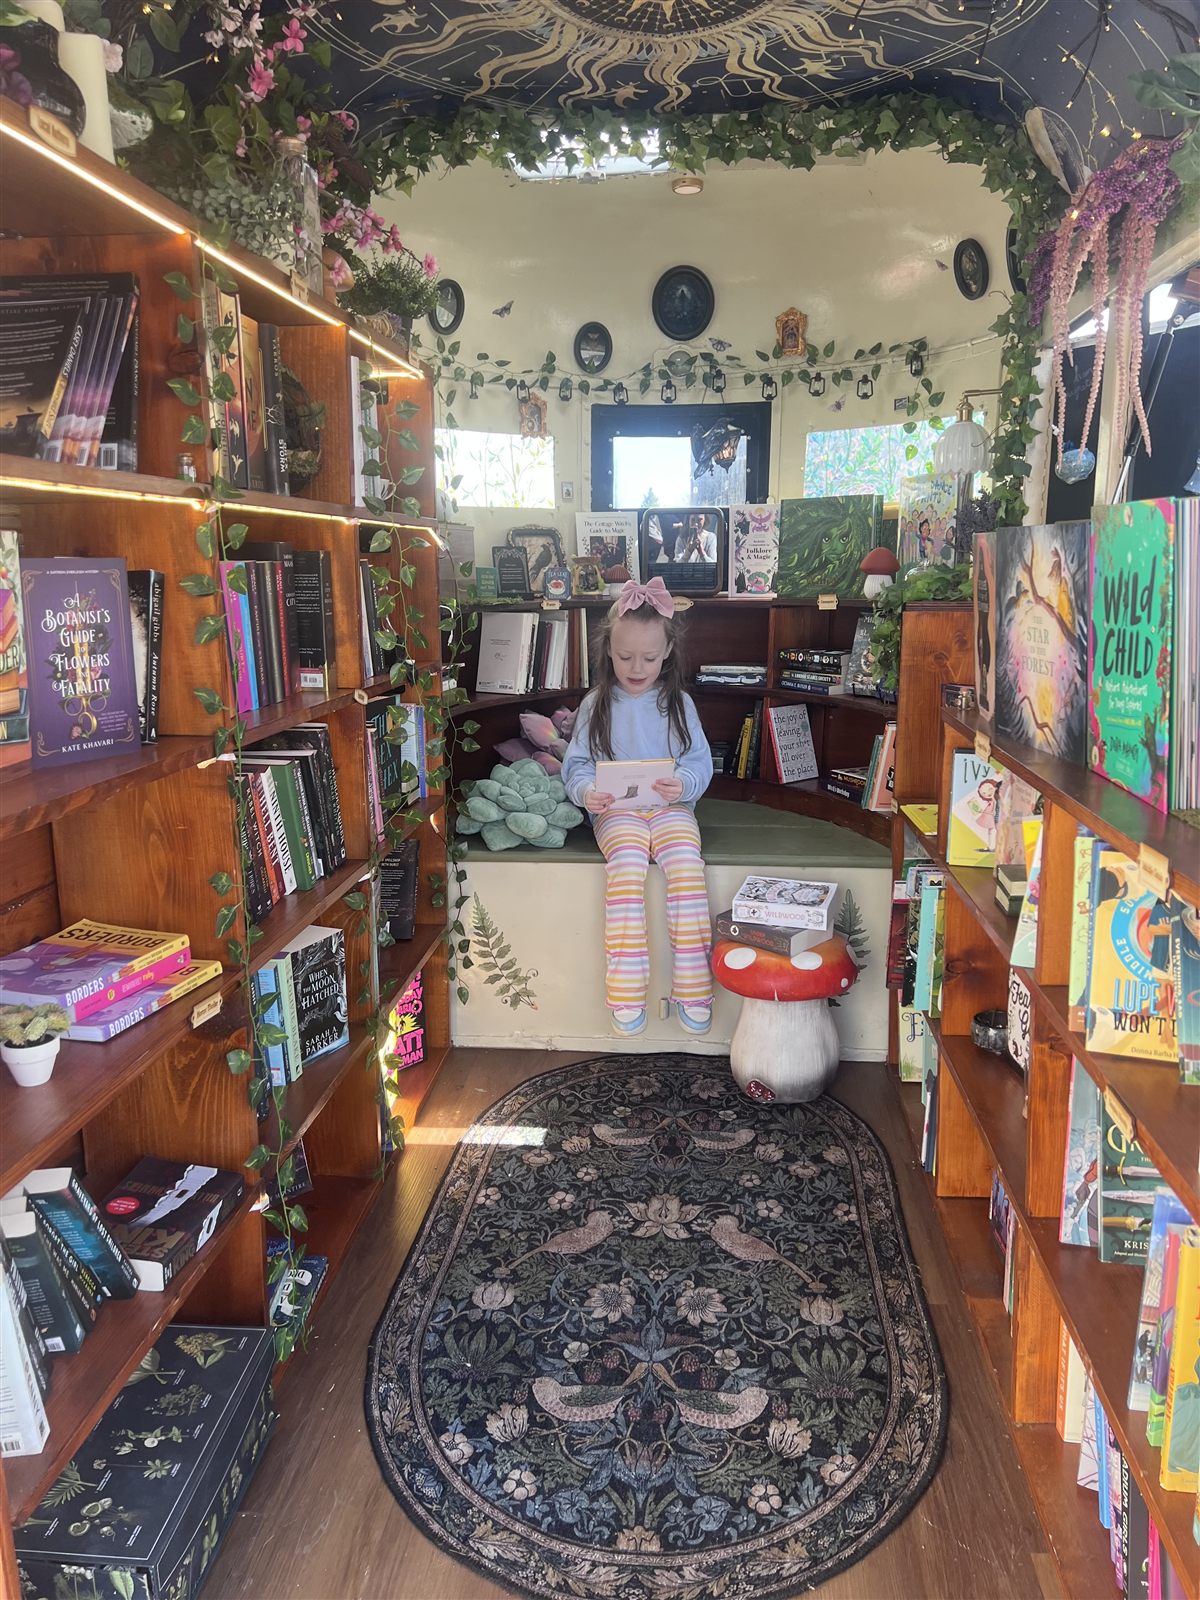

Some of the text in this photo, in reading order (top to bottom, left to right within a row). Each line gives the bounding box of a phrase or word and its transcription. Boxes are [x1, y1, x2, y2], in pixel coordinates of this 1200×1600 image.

[62, 325, 84, 376] CASEY DANIELS
[278, 438, 286, 473] STORM
[64, 593, 80, 608] A
[41, 608, 111, 633] BOTANIST'S
[60, 629, 96, 648] GUIDE
[1027, 627, 1049, 644] STAR
[49, 653, 110, 673] FLOWERS
[1102, 628, 1153, 679] CHILD
[1021, 656, 1055, 677] FOREST
[52, 678, 110, 698] FATALITY
[773, 708, 807, 727] the joy of
[775, 723, 802, 738] leaving
[62, 739, 114, 753] KATE KHAVARI
[780, 742, 796, 755] your
[781, 751, 806, 763] all over
[783, 763, 814, 779] the place
[247, 787, 263, 858] REBEL WITCH
[259, 791, 280, 866] HELL BENT
[268, 789, 292, 875] NINTH HOUSE
[58, 928, 168, 950] BORDERS
[309, 968, 328, 983] WHEN
[310, 974, 337, 993] MOON
[65, 977, 105, 1007] BORDERS
[301, 984, 339, 1010] HATCHED
[1113, 979, 1160, 1016] LUPE
[109, 1007, 145, 1037] BORDERS
[1113, 1013, 1167, 1036] WON'T
[305, 1028, 330, 1047] SARAH
[306, 1032, 339, 1056] PARKER
[1131, 1046, 1171, 1060] Donna Barba
[95, 1222, 109, 1239] LOST
[104, 1236, 124, 1262] CHILDREN
[1124, 1240, 1150, 1250] KRIS
[59, 1243, 71, 1258] THE
[67, 1257, 80, 1272] GIRL
